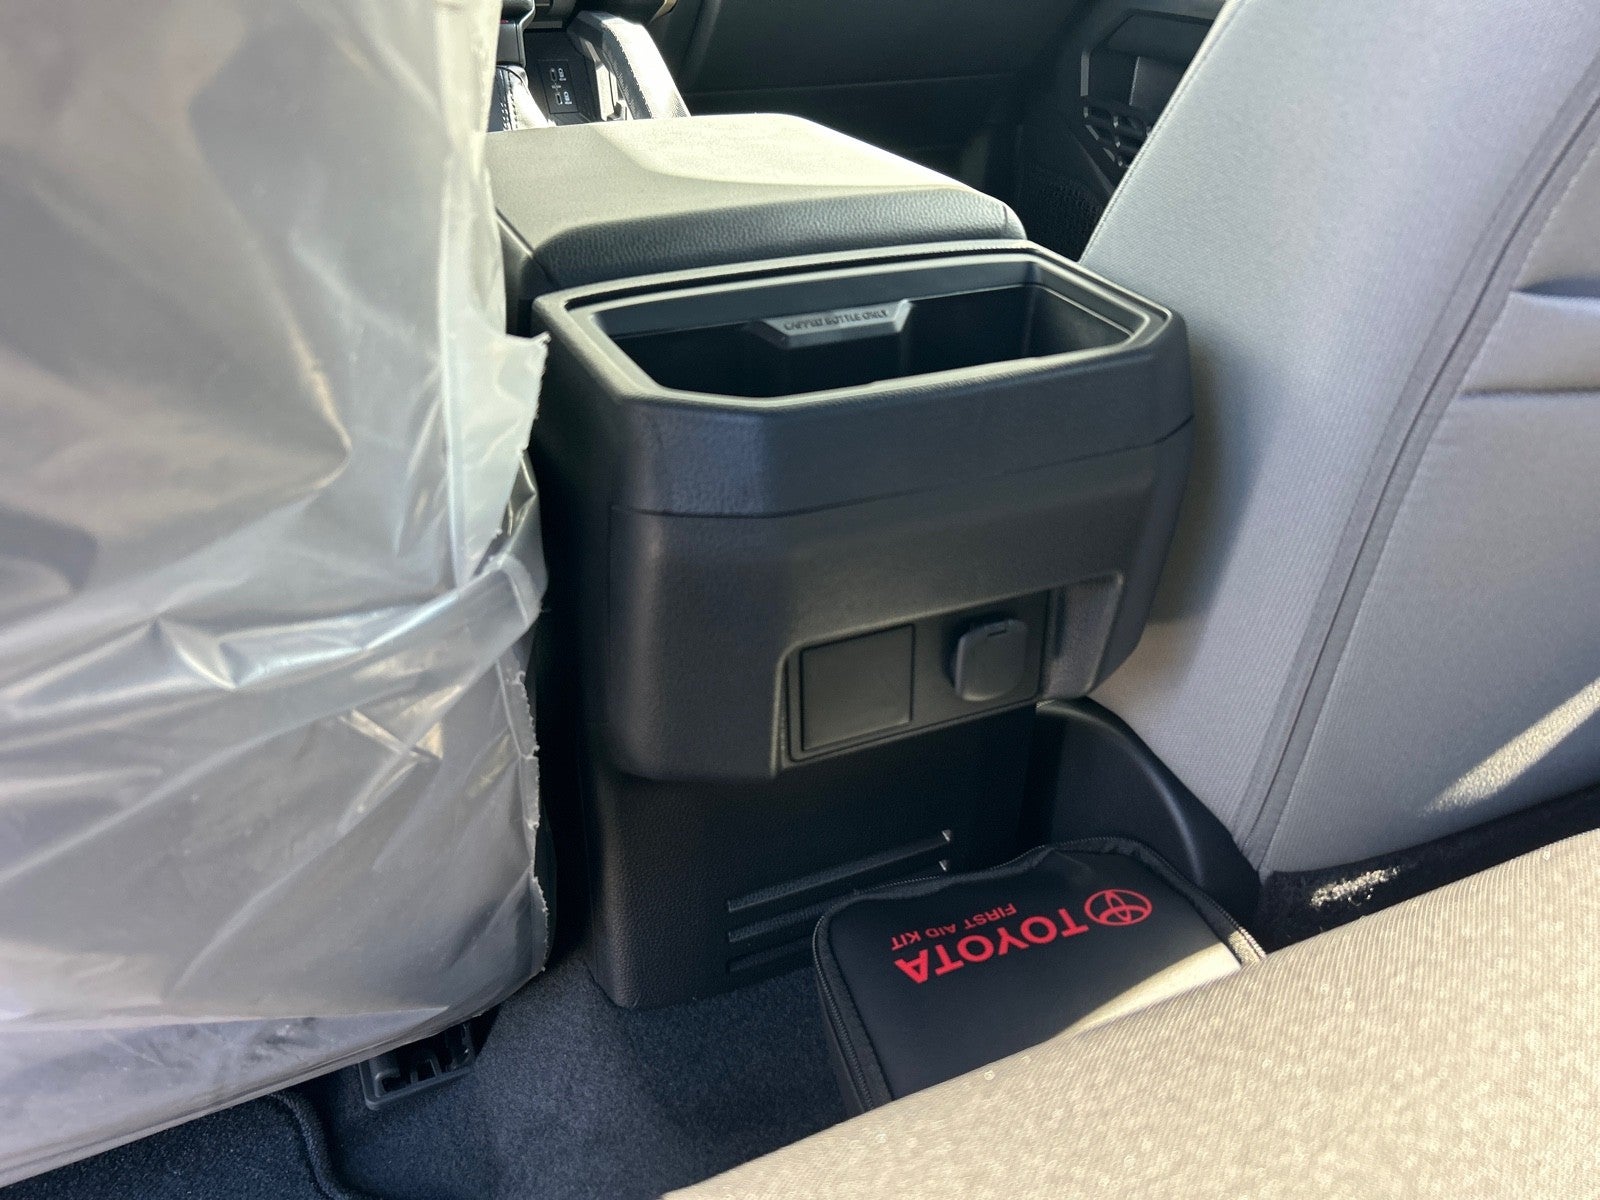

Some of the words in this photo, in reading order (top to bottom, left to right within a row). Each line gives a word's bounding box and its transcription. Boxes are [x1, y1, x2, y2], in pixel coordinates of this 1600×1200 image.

[825, 313, 861, 326] BOTTLE
[862, 309, 888, 321] ONLY
[964, 903, 1017, 930] FIRST
[891, 930, 921, 951] KIT
[925, 923, 956, 939] AID
[894, 908, 1089, 984] TOYOTA
